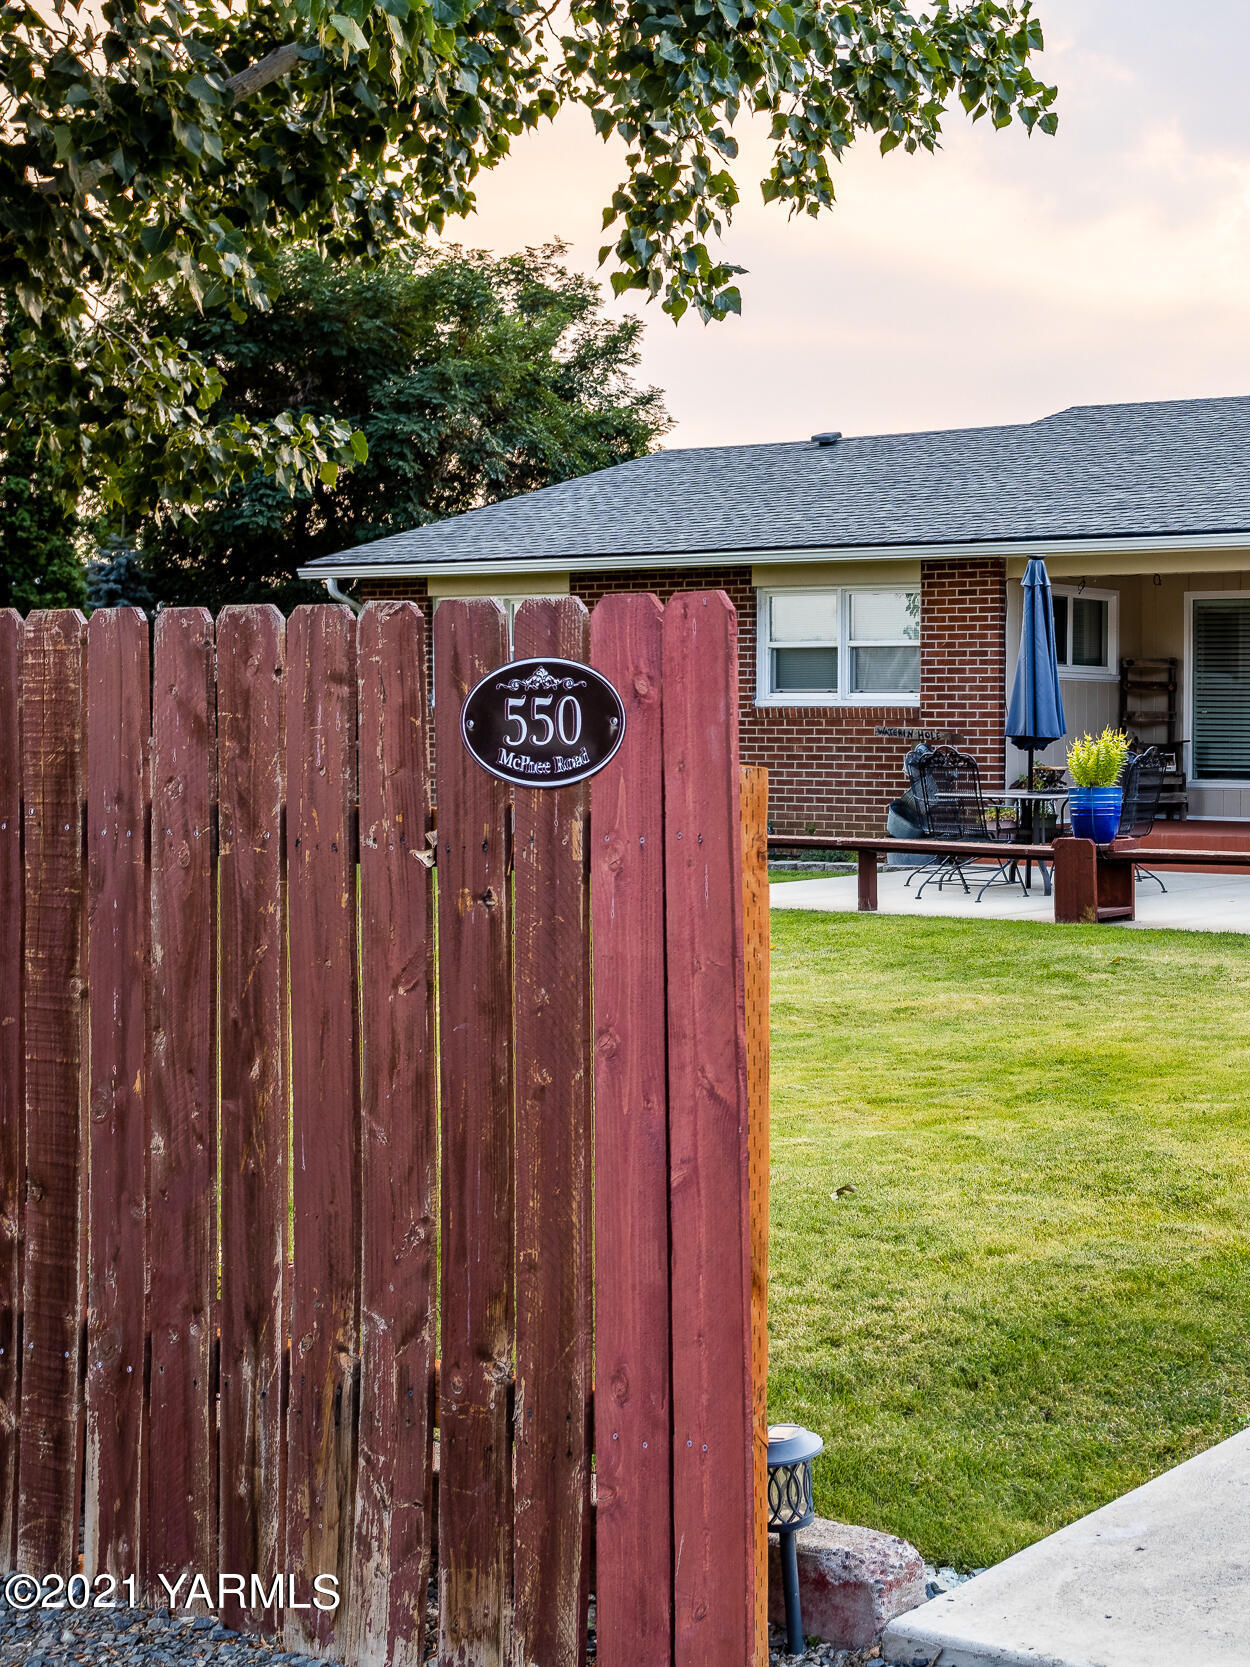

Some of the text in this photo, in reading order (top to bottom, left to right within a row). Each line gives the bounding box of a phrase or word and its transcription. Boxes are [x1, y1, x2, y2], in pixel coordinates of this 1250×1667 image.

[503, 694, 582, 746] 550
[918, 730, 941, 741] HOLE
[496, 746, 590, 774] McPhee Road
